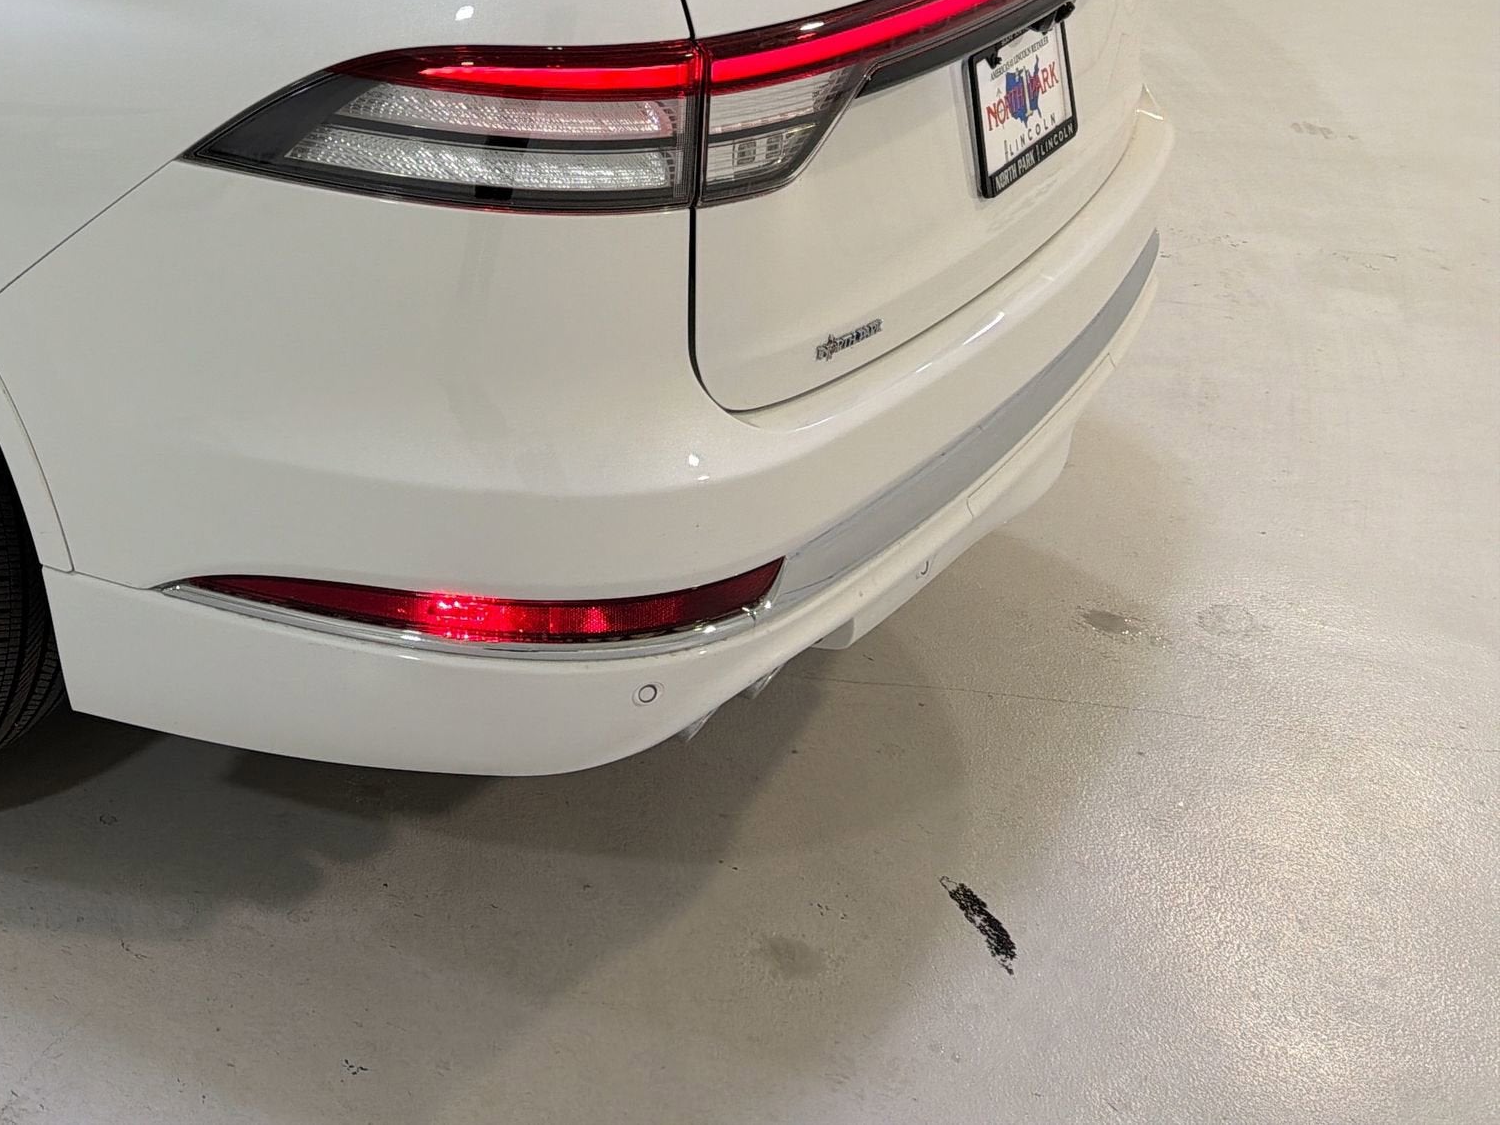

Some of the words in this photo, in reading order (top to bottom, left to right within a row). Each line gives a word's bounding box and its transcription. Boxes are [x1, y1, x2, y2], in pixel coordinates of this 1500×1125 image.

[985, 85, 1026, 132] NORTH
[1028, 61, 1060, 96] PARK
[995, 163, 1018, 192] NORTH
[1017, 149, 1036, 176] PARK
[1040, 123, 1074, 156] LINCOLN
[1008, 113, 1056, 157] LINCOLN
